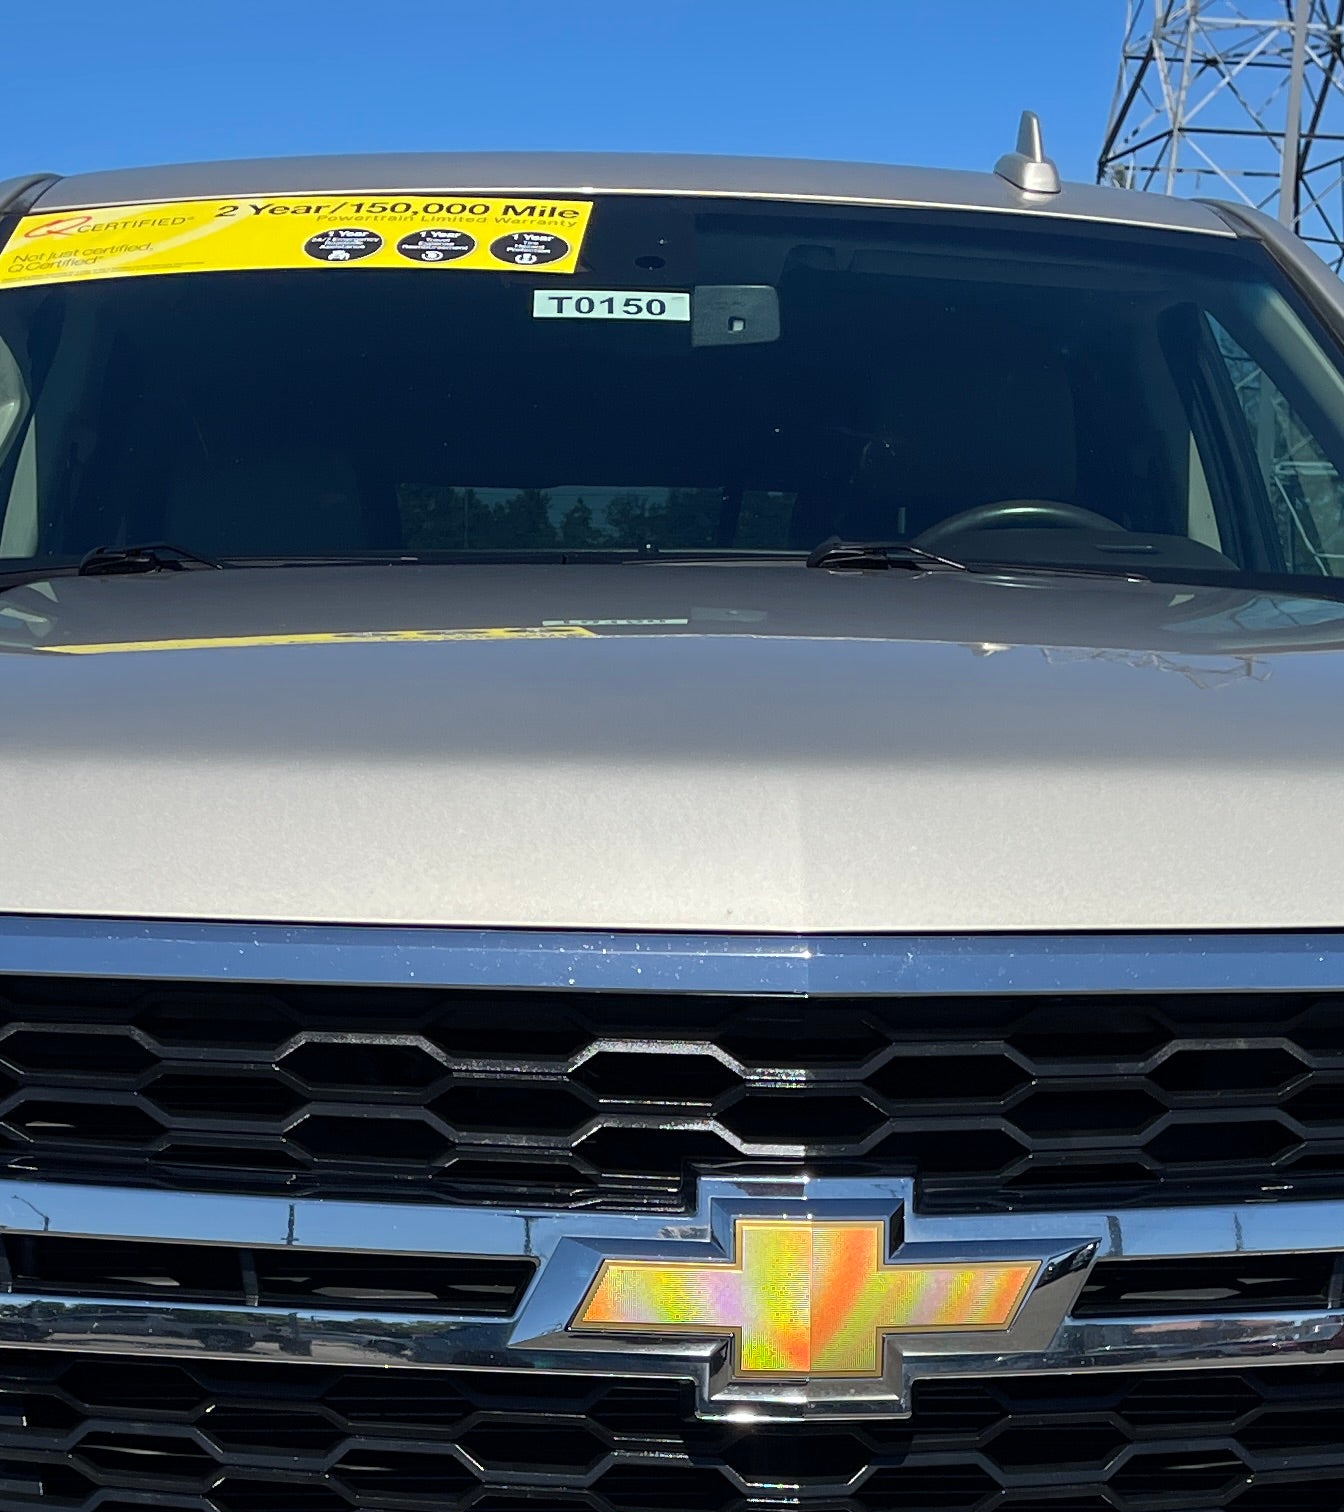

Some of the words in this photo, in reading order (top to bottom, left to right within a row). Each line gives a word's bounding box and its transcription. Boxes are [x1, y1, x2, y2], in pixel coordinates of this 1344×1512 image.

[214, 204, 240, 218] 2
[249, 201, 491, 217] Year/150,000
[501, 204, 580, 219] Mile
[316, 214, 414, 223] Powertrain
[421, 214, 487, 224] Limited
[494, 217, 577, 228] Warranty
[339, 230, 369, 238] Year
[431, 231, 461, 239] Year
[523, 233, 554, 242] Year
[12, 252, 47, 264] Not
[47, 249, 79, 262] just
[548, 296, 666, 316] T0150
